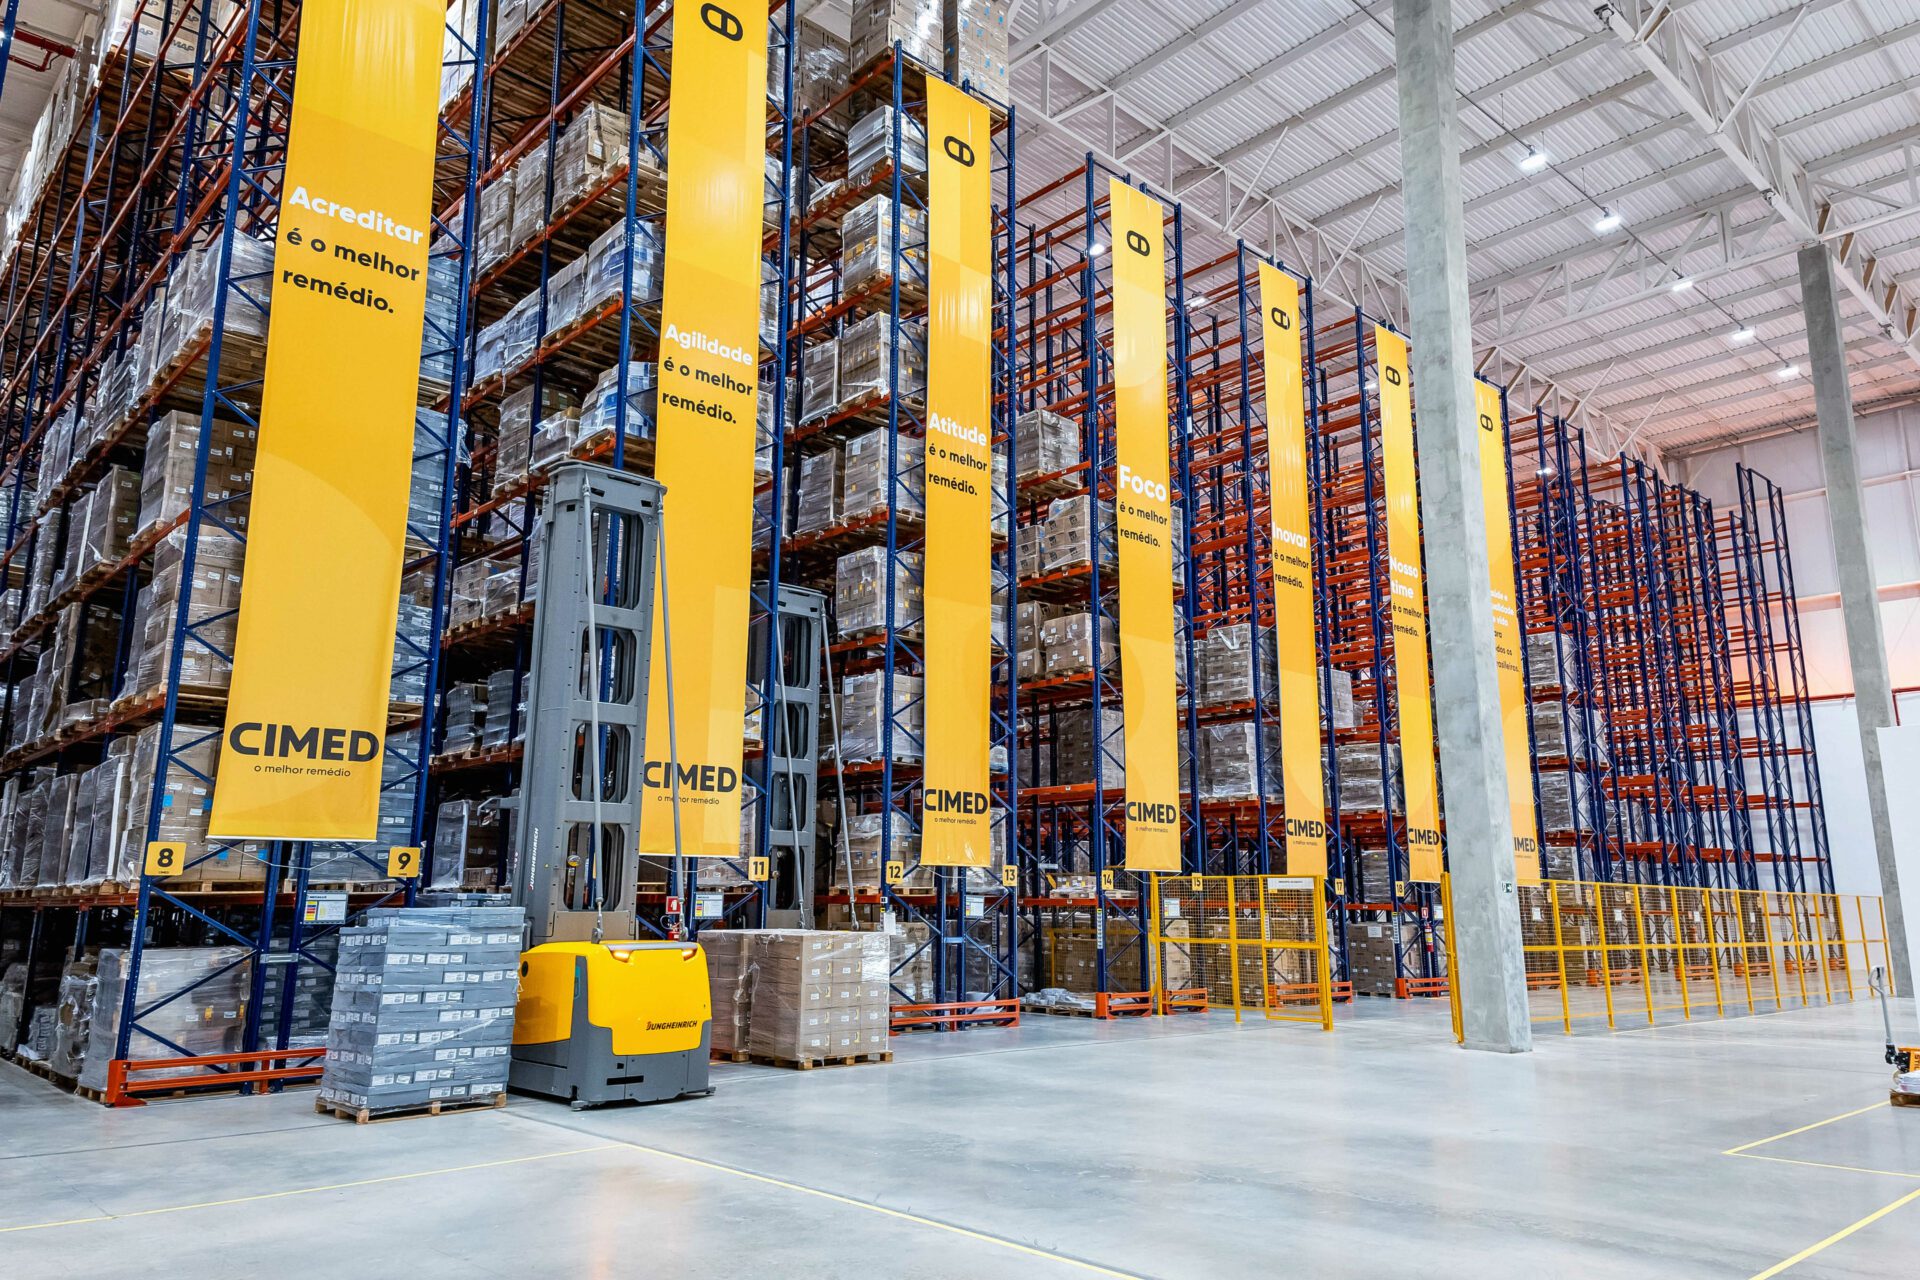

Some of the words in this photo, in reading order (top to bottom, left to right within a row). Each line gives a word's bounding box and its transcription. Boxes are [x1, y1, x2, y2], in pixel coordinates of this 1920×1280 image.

[288, 185, 424, 246] Acreditar
[286, 227, 303, 246] é
[310, 237, 326, 253] o
[333, 243, 420, 282] melhor
[282, 268, 394, 314] remédio.
[664, 323, 753, 366] Agilidade
[663, 356, 675, 372] é
[679, 364, 690, 377] o
[695, 368, 753, 396] melhor
[662, 392, 737, 424] remédio.
[928, 412, 987, 447] Atitude
[928, 442, 936, 456] é
[939, 449, 946, 459] o
[949, 451, 988, 472] melhor
[928, 473, 978, 496] remédio.
[1119, 464, 1167, 503] Foco
[1119, 501, 1126, 513] é
[1128, 506, 1135, 515] o
[1136, 508, 1168, 526] melhor
[1120, 528, 1161, 548] remédio.
[1271, 521, 1308, 549] Inovar
[1274, 549, 1279, 559] é
[1280, 554, 1285, 562] o
[1286, 555, 1309, 570] melhor
[1389, 555, 1419, 579] Nosso
[1275, 573, 1305, 589] remédio.
[1390, 580, 1414, 600] time
[1398, 605, 1402, 613] o
[1403, 607, 1422, 619] melhor
[1393, 623, 1420, 637] remédio.
[228, 721, 380, 763] CIMED
[253, 764, 262, 774] o
[263, 762, 304, 776] melhor
[305, 764, 352, 778] remédio
[643, 760, 738, 793] CIMED
[690, 795, 720, 805] remédio
[924, 788, 989, 815] CIMED
[938, 817, 956, 825] melhor
[1125, 801, 1177, 824] CIMED
[1286, 818, 1325, 839] CIMED
[1408, 827, 1440, 846] CIMED
[1514, 836, 1536, 853] IMED
[157, 847, 174, 868] 8
[398, 852, 412, 870] 9
[528, 827, 539, 891] JUNGHEINRICH
[753, 861, 765, 876] 11
[888, 865, 901, 879] 12
[1005, 869, 1016, 881] 13
[1102, 873, 1112, 886] 14
[1194, 877, 1201, 887] 15
[1336, 881, 1343, 891] 17
[1396, 883, 1403, 894] 18
[645, 1020, 698, 1031] JUNGHEINRICH
